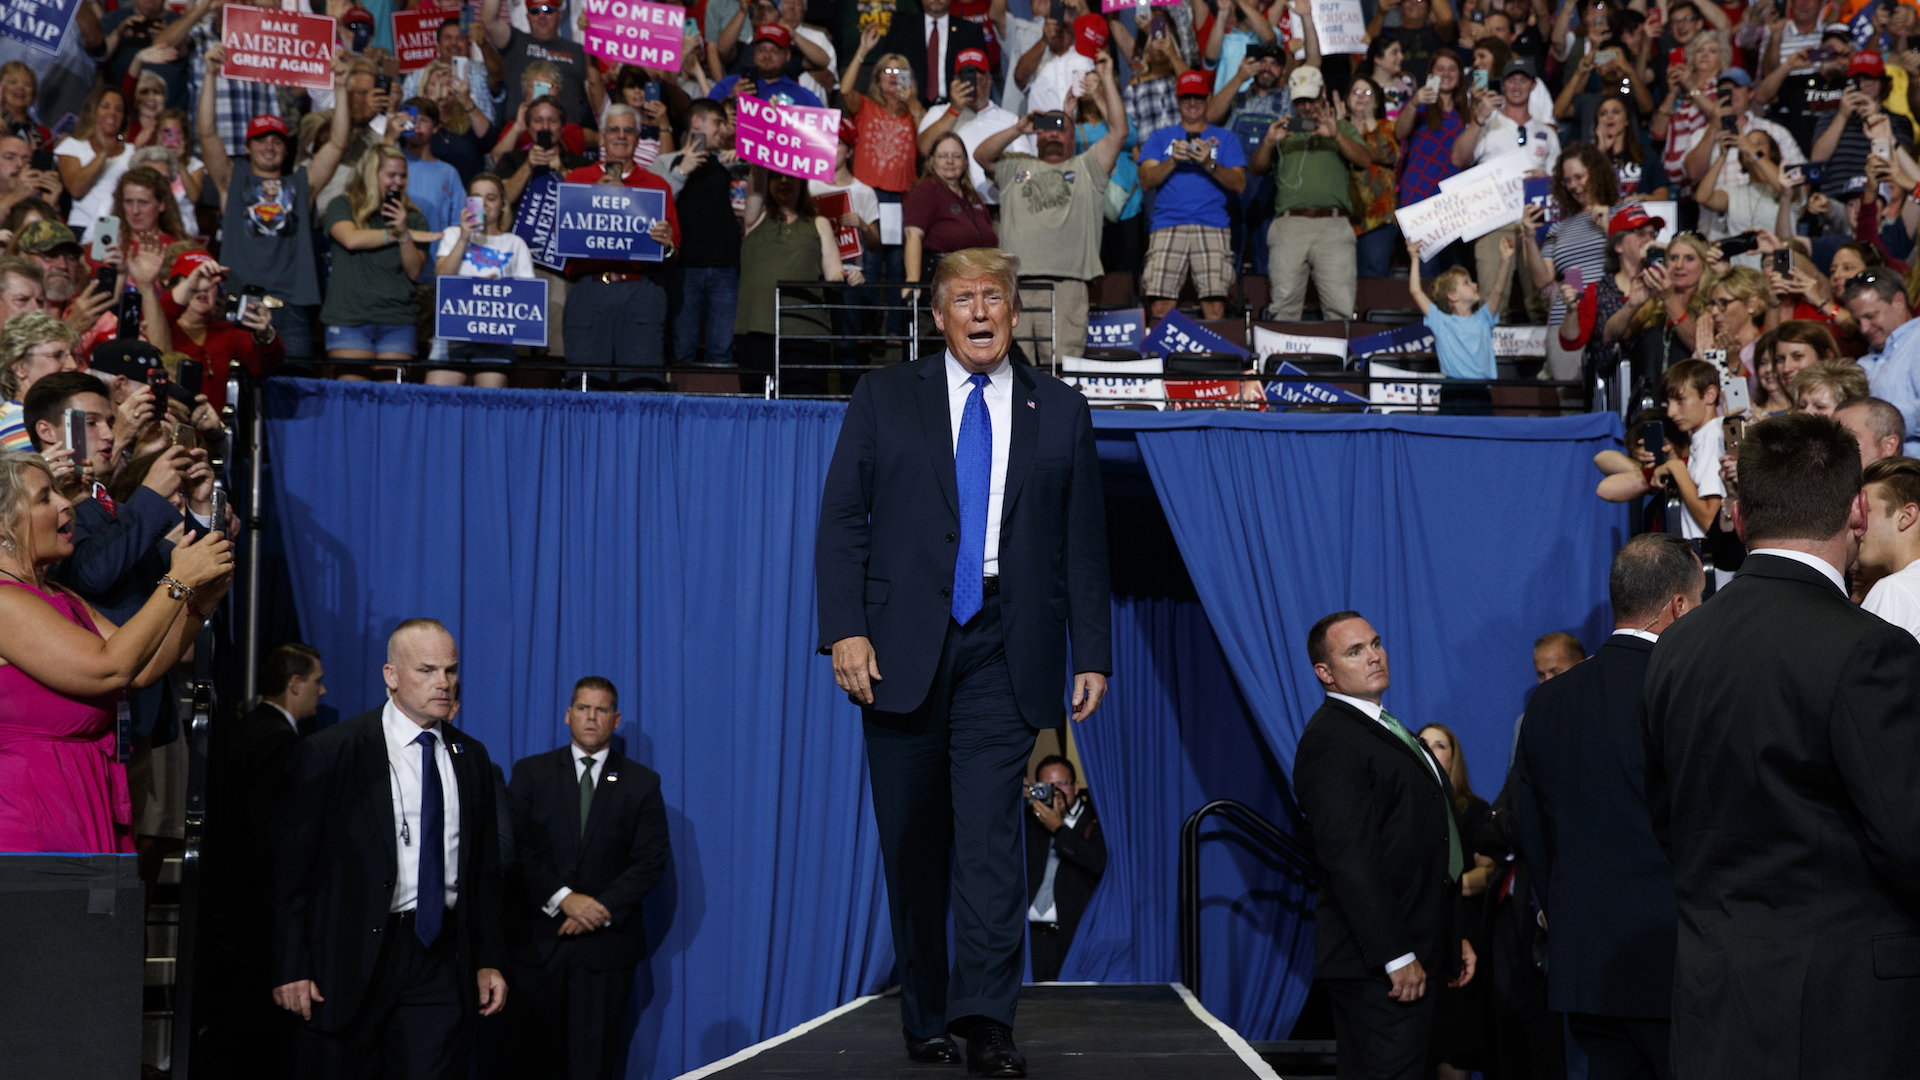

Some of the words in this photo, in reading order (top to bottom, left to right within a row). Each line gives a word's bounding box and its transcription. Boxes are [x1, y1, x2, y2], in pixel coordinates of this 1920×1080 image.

[418, 17, 446, 29] MAK
[588, 0, 685, 28] WOMEN
[261, 19, 299, 35] MAKE
[615, 24, 650, 41] FOR
[226, 31, 332, 60] AMERICA
[402, 49, 435, 61] GREAT
[589, 36, 676, 65] TRUMP
[232, 52, 278, 69] GREAT
[279, 58, 325, 75] AGAIN
[739, 96, 839, 133] WOMEN
[766, 129, 802, 149] FOR
[741, 137, 829, 175] TRUMP
[525, 192, 543, 226] MAKE
[591, 195, 631, 210] KEEP
[560, 211, 657, 234] AMERICA
[585, 235, 634, 251] GREAT
[472, 284, 513, 297] KEEP
[440, 298, 544, 321] AMERICA
[467, 321, 516, 336] GREAT
[1087, 322, 1137, 336] UMP
[1195, 385, 1228, 398] MAKE
[1303, 382, 1339, 403] KEEP
